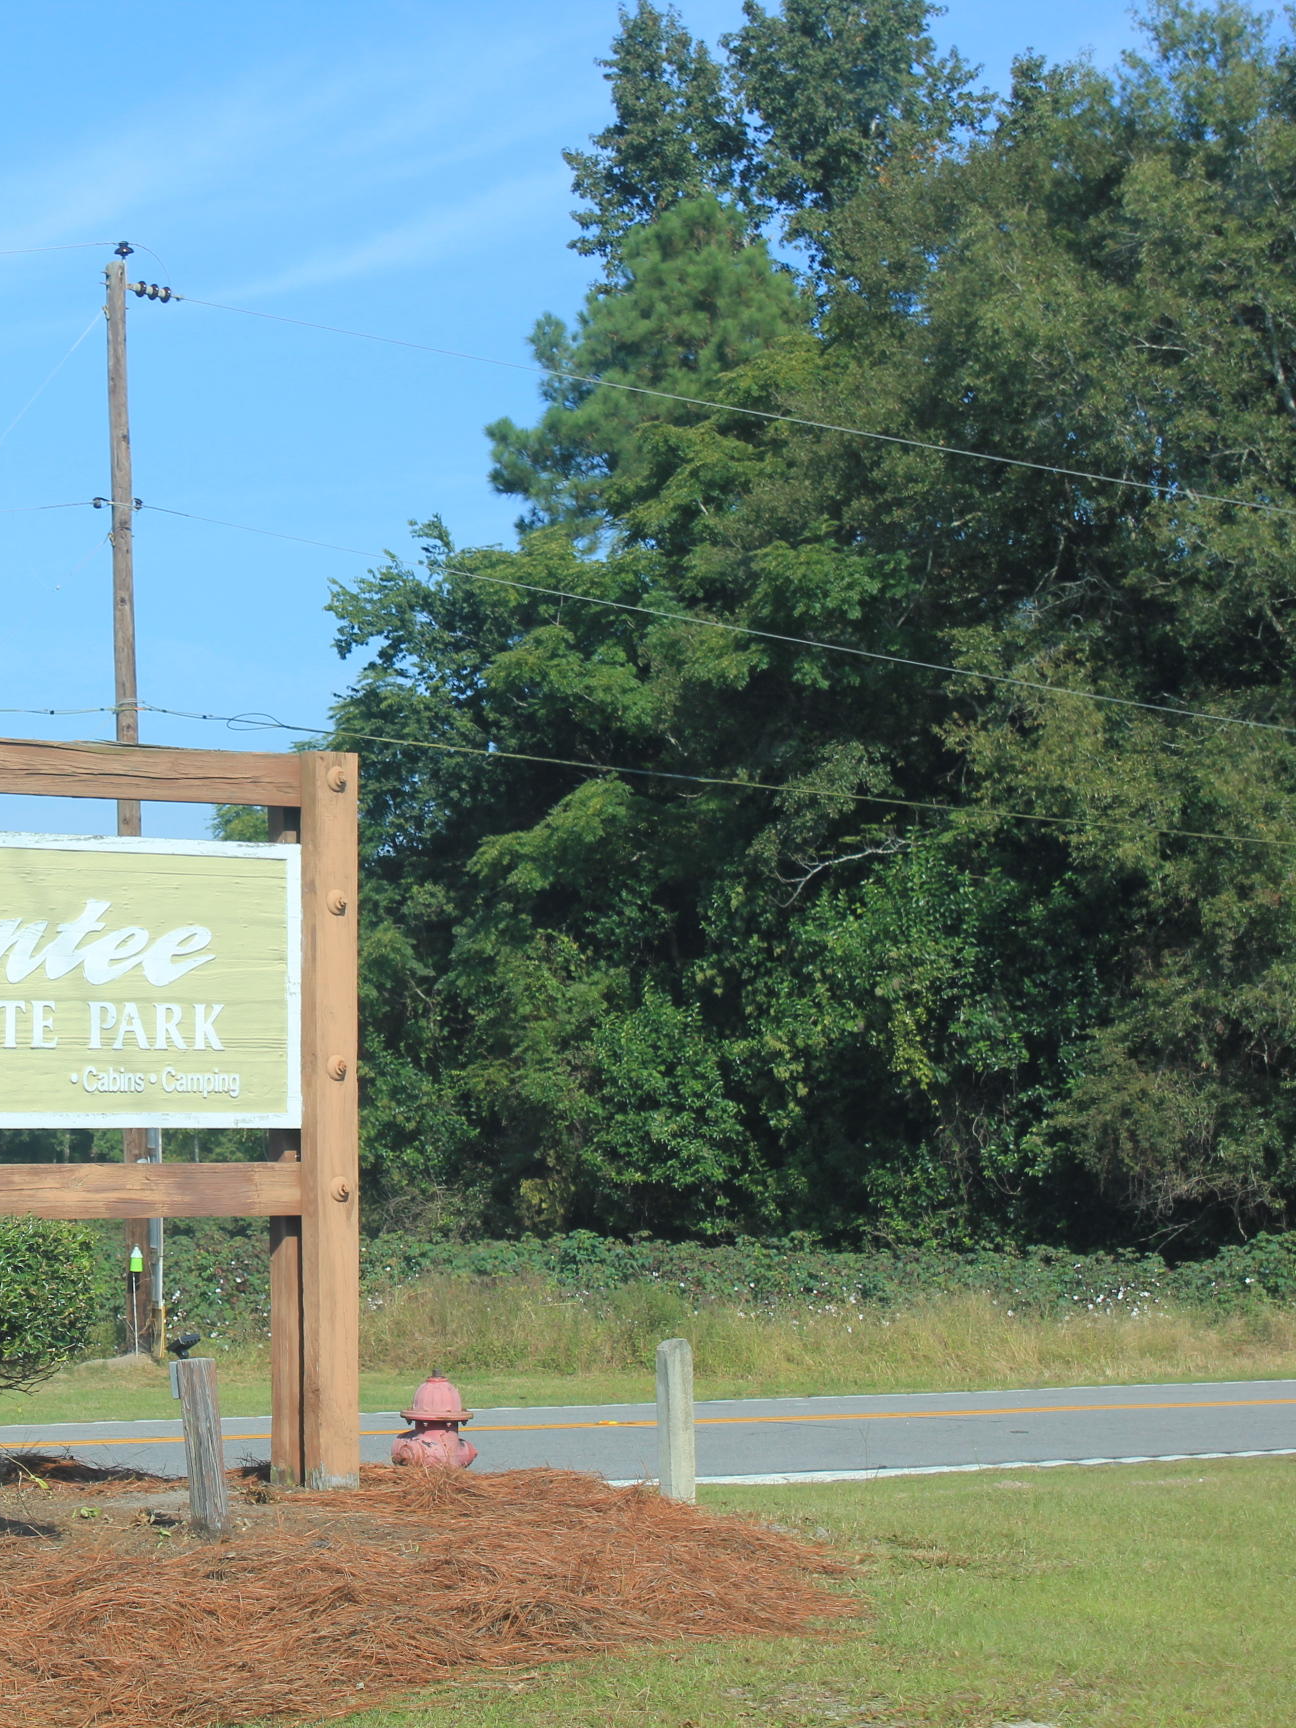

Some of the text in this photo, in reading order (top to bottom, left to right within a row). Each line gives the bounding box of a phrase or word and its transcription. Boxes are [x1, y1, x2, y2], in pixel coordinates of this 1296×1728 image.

[88, 1001, 226, 1053] PARK
[82, 1067, 241, 1099] Cabins Camping
